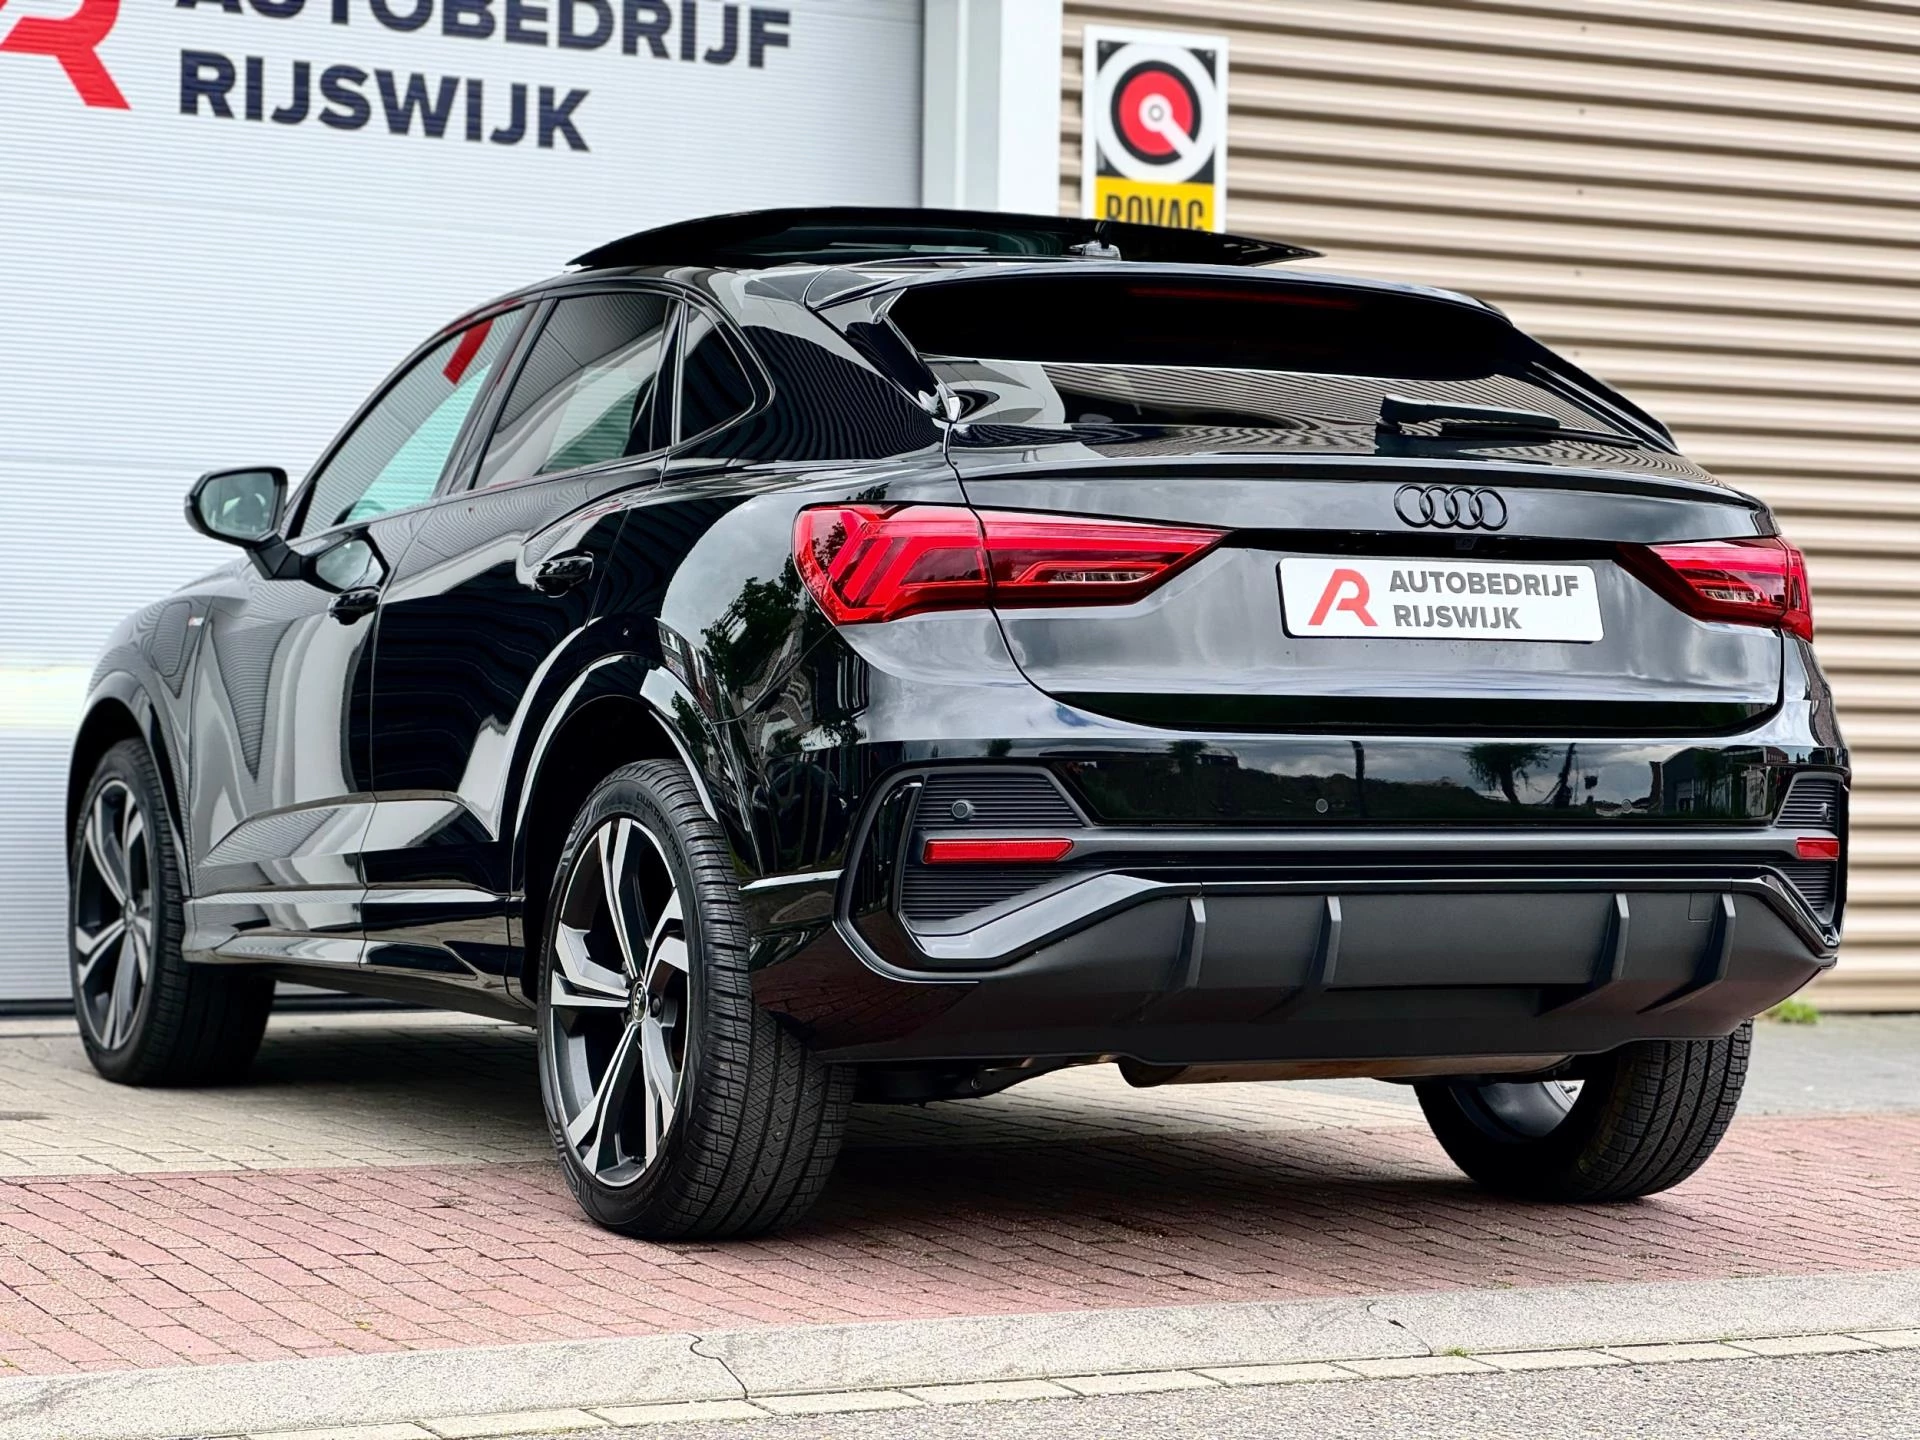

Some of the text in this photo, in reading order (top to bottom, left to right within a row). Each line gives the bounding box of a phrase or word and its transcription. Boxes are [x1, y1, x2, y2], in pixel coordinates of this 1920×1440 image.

[176, 0, 791, 69] BEDRIJF
[180, 48, 591, 152] RIJSWIJK
[1389, 570, 1579, 597] AUTOBEDRIJF
[1393, 604, 1522, 630] RIJSWIJK
